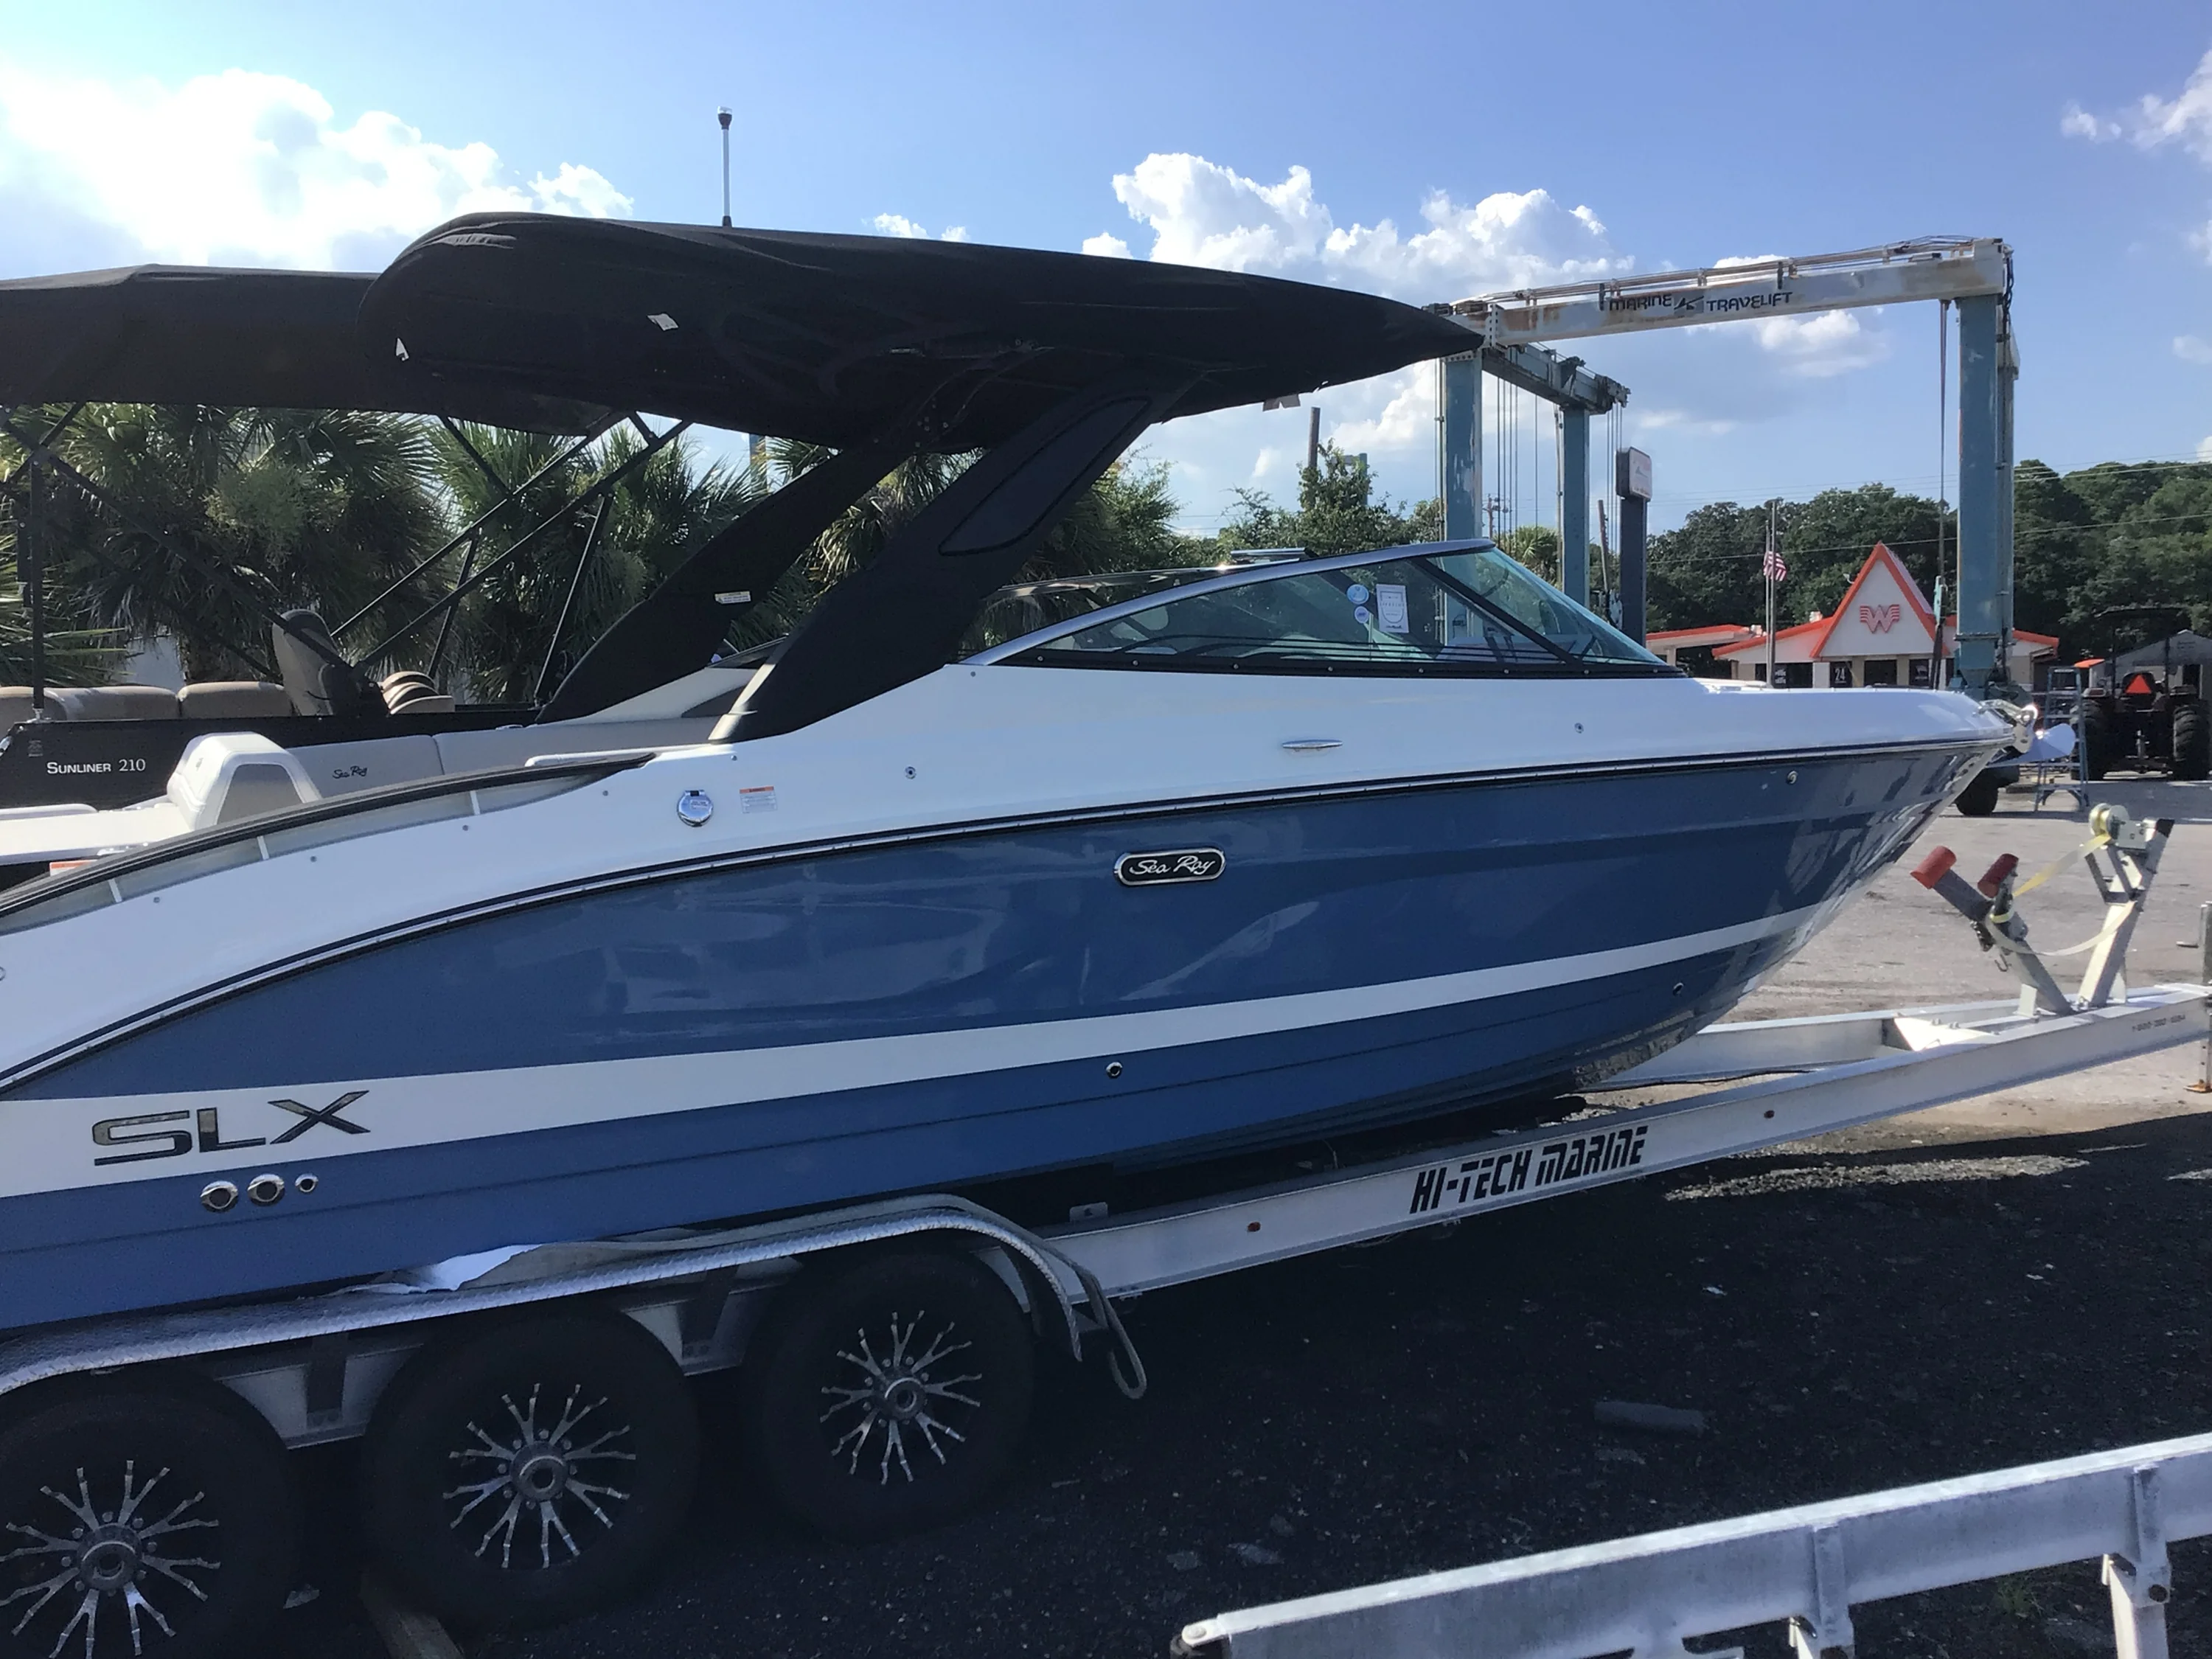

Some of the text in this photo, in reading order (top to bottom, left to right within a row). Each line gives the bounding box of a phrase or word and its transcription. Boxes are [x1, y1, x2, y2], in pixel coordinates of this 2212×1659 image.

[1609, 291, 1793, 312] MARINE TRAVELIFT
[1860, 604, 1900, 634] W
[46, 758, 146, 774] SUNLINER 210
[332, 769, 350, 779] Sea
[1129, 855, 1216, 875] Sea Ray
[91, 1090, 372, 1166] SLX
[1409, 1124, 1649, 1215] HI-TECH MARINE
